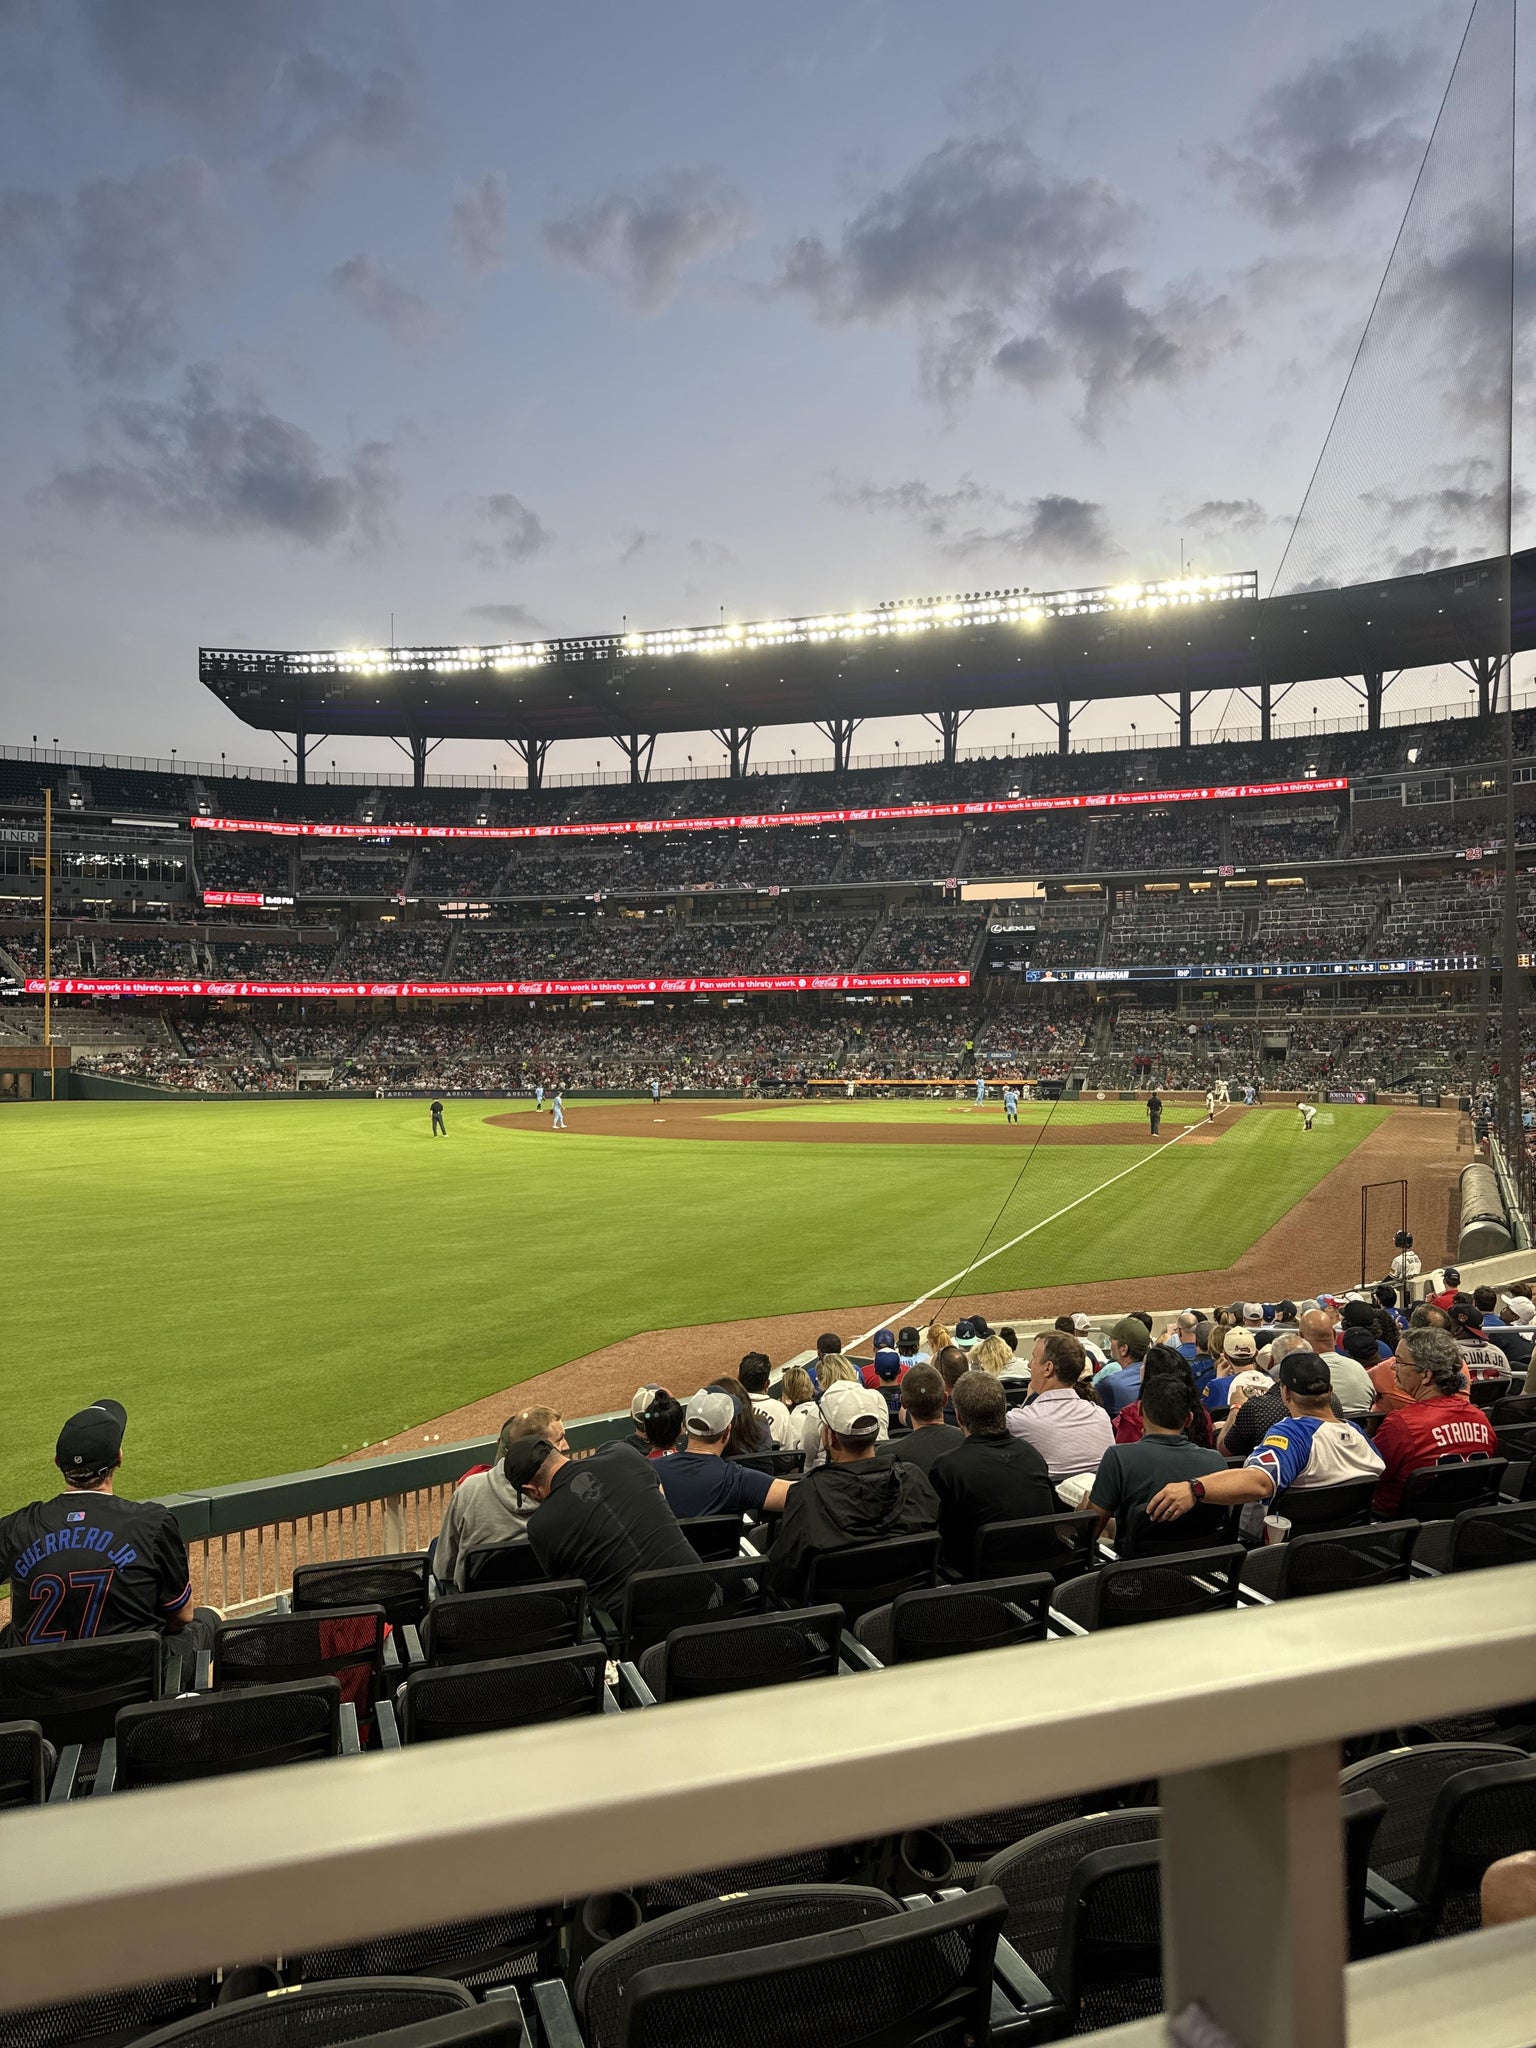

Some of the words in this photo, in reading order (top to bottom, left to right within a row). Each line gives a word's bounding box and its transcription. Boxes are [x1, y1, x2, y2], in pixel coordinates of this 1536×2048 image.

[1290, 783, 1313, 791] thirsty
[1158, 792, 1179, 800] thirsty
[262, 823, 283, 831] thirsty
[1074, 972, 1096, 980] KEVIN
[1096, 971, 1130, 979] GAUSMAN
[661, 980, 687, 991] Coca-Cola
[812, 977, 839, 987] Coca-Cola
[902, 977, 932, 985] thirsty
[133, 984, 164, 992] thirsty
[208, 984, 237, 993] Coca-Cola
[371, 985, 399, 994] Coca-Cola
[460, 986, 484, 994] thirsty
[519, 984, 544, 993] Coca-Cola
[1463, 1351, 1493, 1365] CUNA
[1431, 1422, 1489, 1447] STRIDER
[15, 1527, 114, 1578] GUERRERO
[107, 1543, 137, 1573] JR.
[25, 1569, 115, 1646] 27
